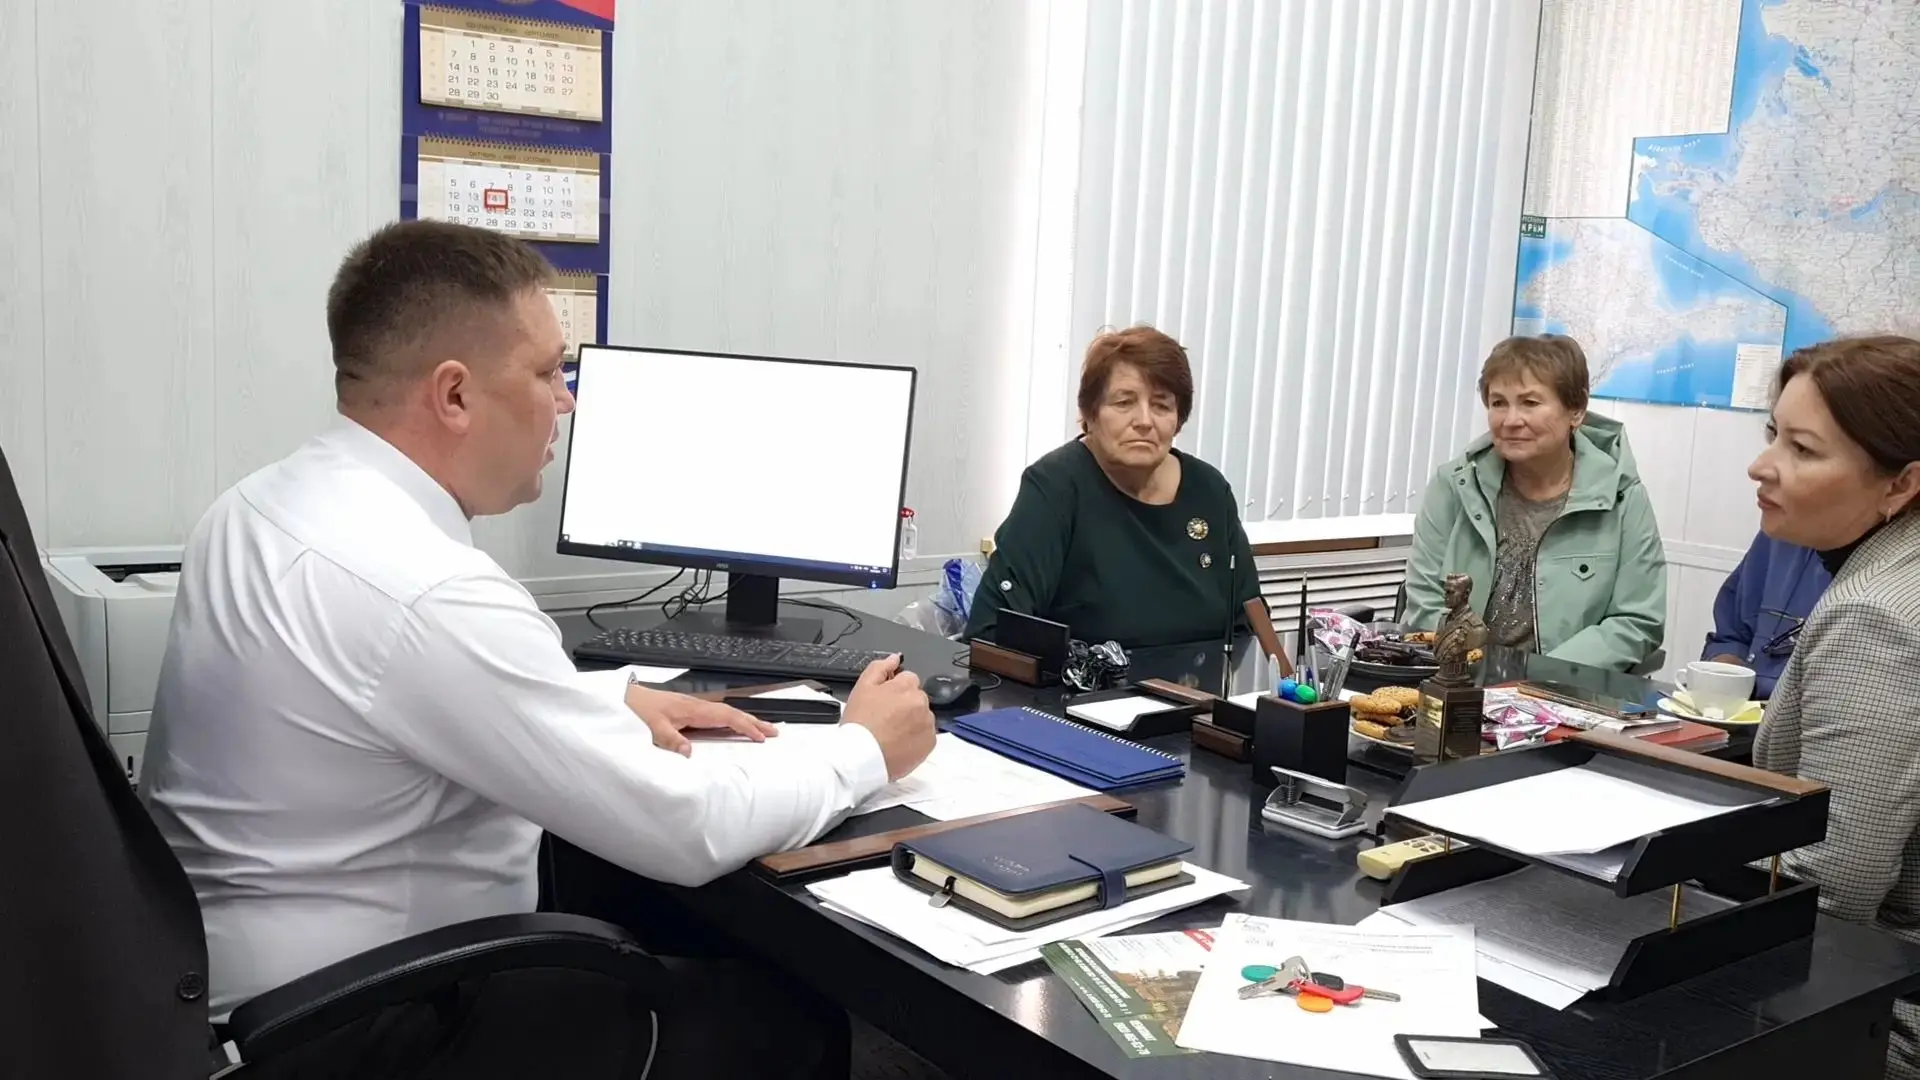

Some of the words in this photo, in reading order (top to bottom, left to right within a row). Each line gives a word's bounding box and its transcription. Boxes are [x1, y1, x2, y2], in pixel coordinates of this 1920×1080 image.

[471, 40, 475, 48] 1
[490, 55, 495, 63] 9
[506, 57, 518, 65] 10
[526, 59, 535, 67] 11
[562, 64, 573, 72] 13
[449, 63, 460, 71] 14
[469, 65, 479, 73] 15
[488, 67, 498, 76] 16
[526, 72, 536, 80] 18
[545, 74, 555, 82] 19
[562, 76, 573, 84] 20
[448, 88, 460, 96] 28
[467, 90, 480, 98] 29
[487, 92, 499, 100] 30
[487, 80, 498, 88] 23
[506, 82, 517, 90] 24
[525, 84, 536, 92] 25
[544, 86, 555, 94] 26
[561, 88, 573, 96] 27
[543, 187, 553, 195] 10
[469, 193, 479, 201] 13
[525, 197, 534, 205] 16
[449, 204, 460, 212] 19
[561, 211, 572, 219] 25
